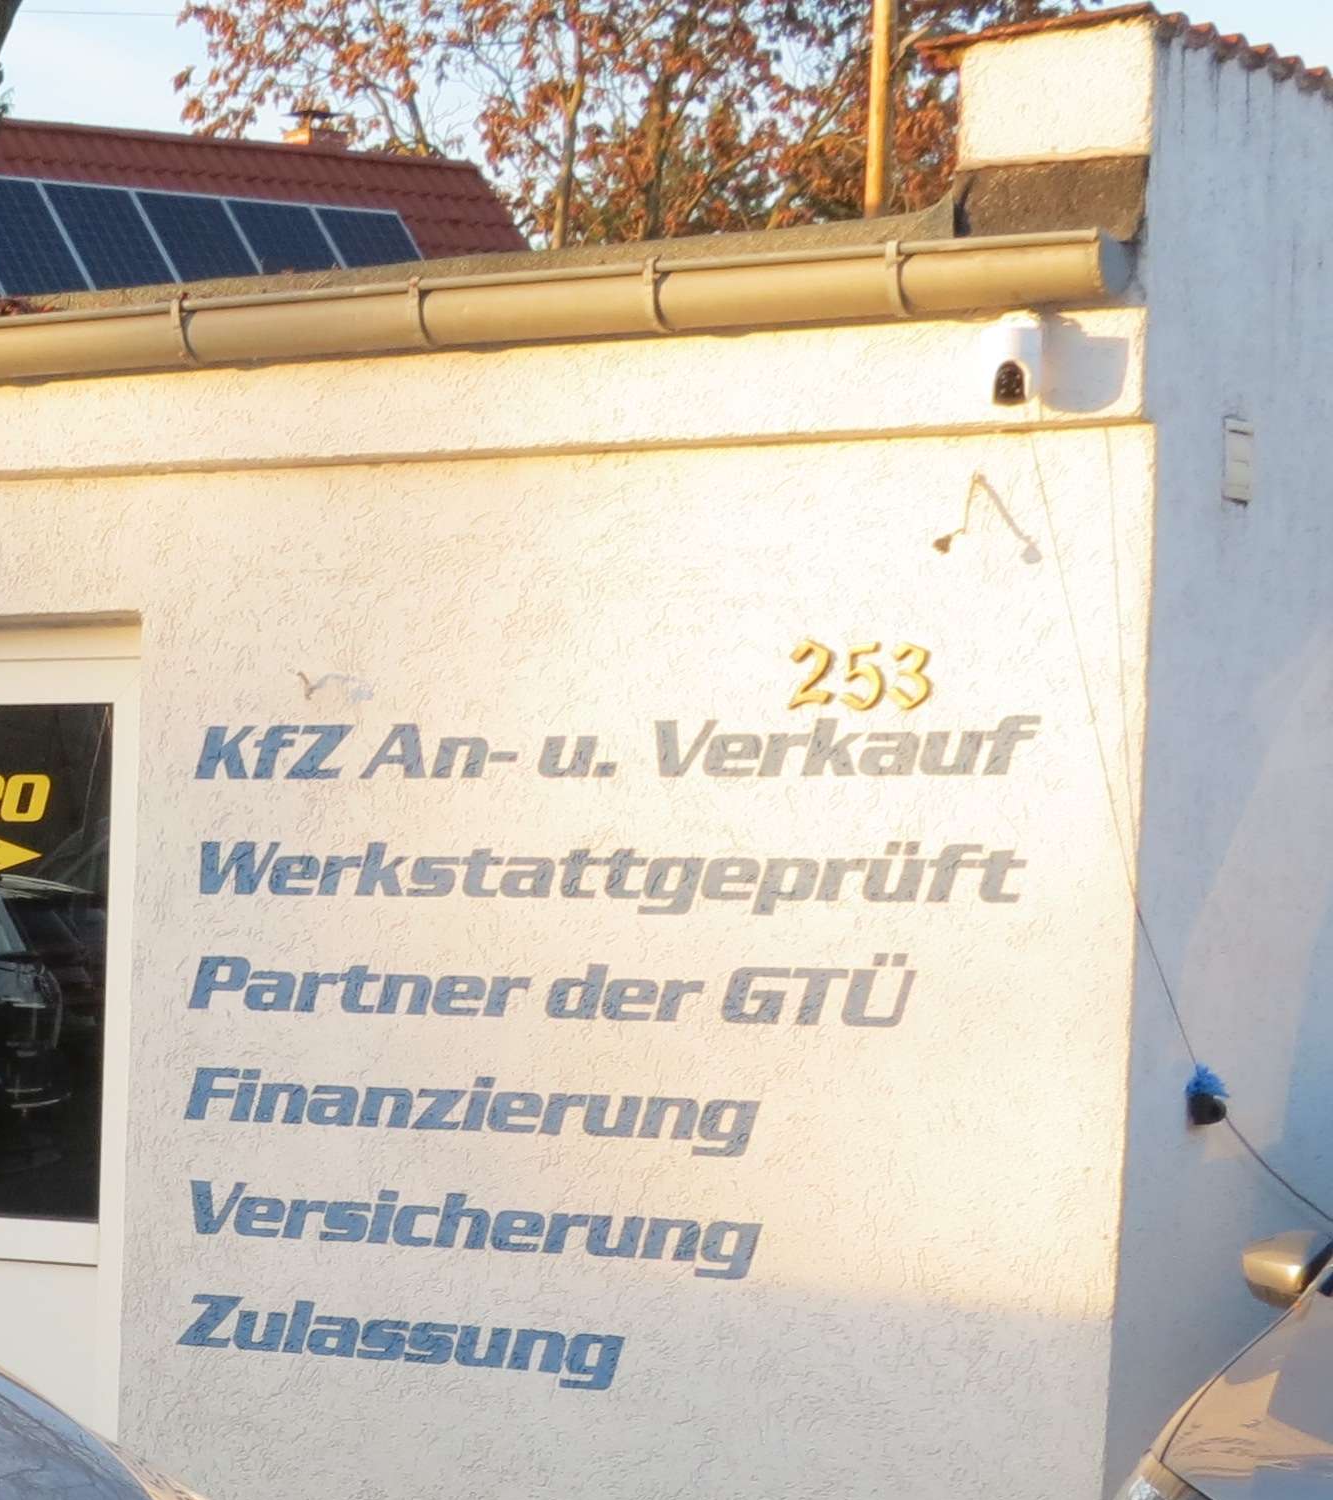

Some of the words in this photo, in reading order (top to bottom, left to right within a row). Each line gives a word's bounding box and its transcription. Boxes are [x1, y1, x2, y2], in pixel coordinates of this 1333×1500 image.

[786, 638, 933, 711] 253
[193, 723, 348, 781] KfZ
[360, 724, 517, 781] An-
[537, 735, 616, 780] u.
[653, 714, 1042, 780] Verkauf
[196, 840, 1029, 915] Werkstattgeprüft
[188, 955, 530, 1019] Partner
[545, 963, 702, 1026] der
[721, 953, 917, 1028] GTÜ
[183, 1066, 761, 1157] Finanzierung
[188, 1179, 764, 1280] Versicherung
[177, 1293, 625, 1391] Zulassung
